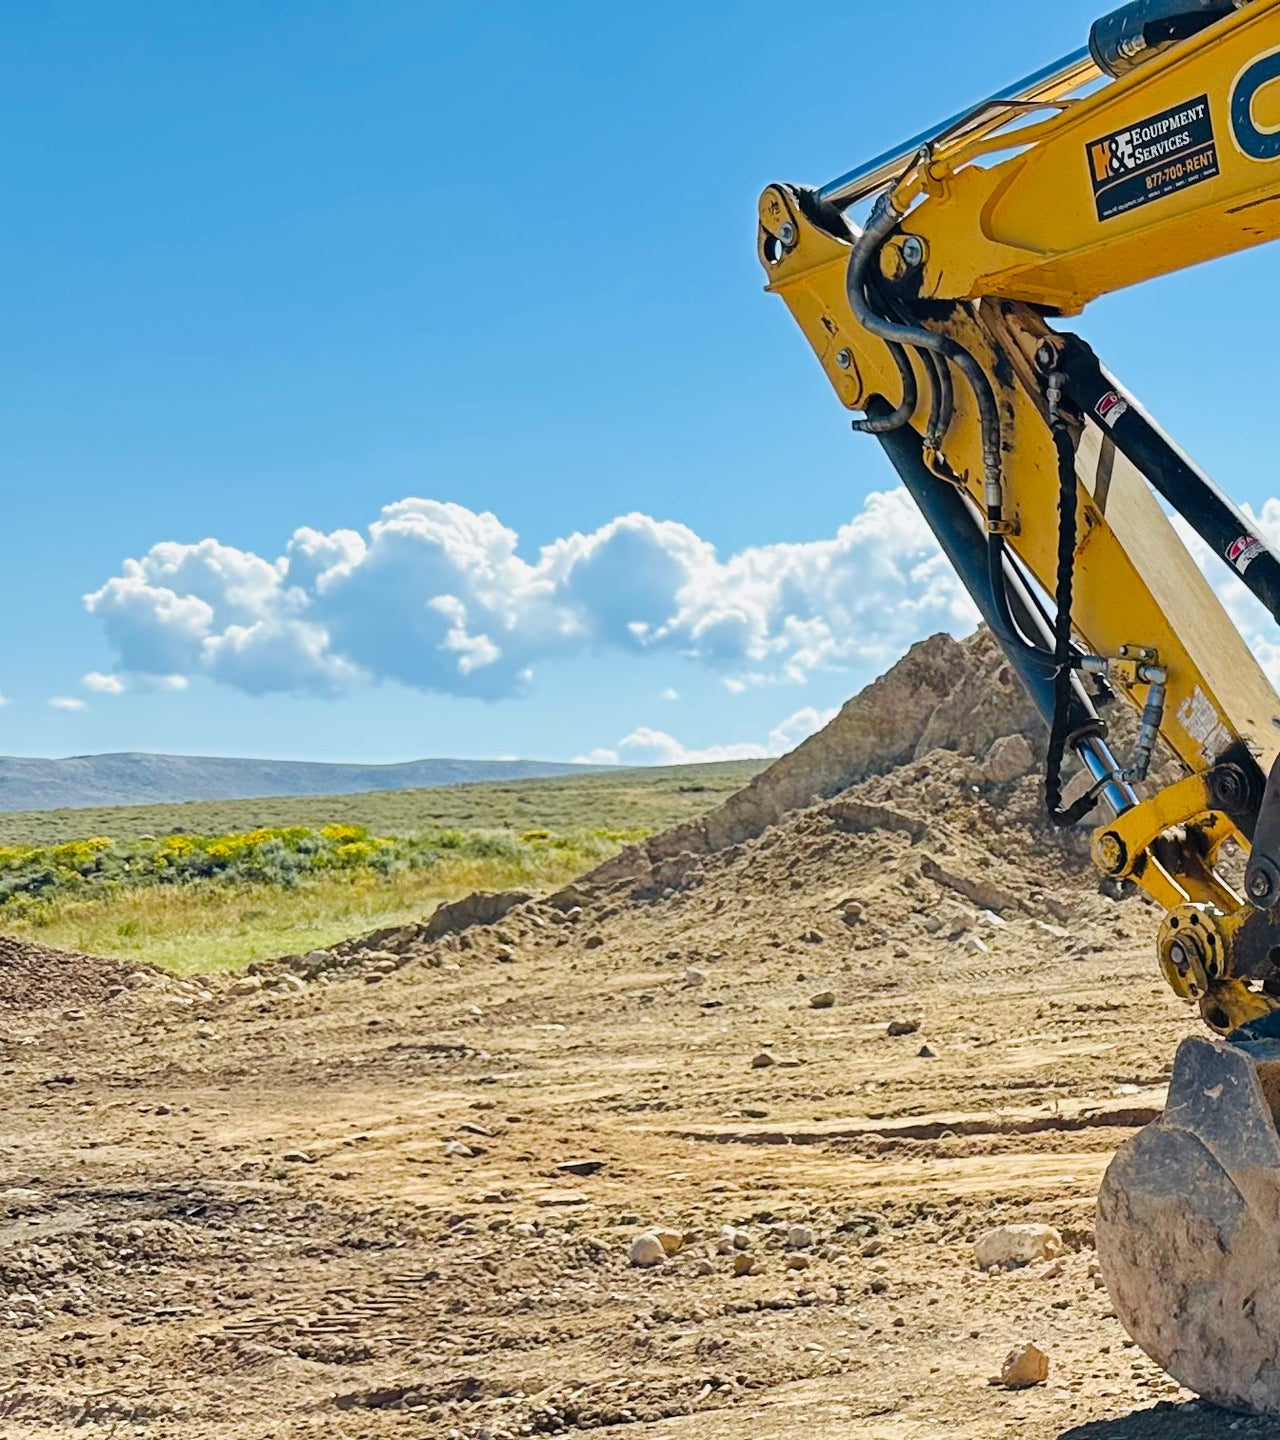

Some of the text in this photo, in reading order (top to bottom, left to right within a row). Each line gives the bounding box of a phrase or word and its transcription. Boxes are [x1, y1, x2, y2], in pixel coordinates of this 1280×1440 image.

[1131, 104, 1204, 145] EQUIPMENT
[1134, 131, 1191, 164] SERVICES
[1145, 150, 1214, 189] 877-700-RENT
